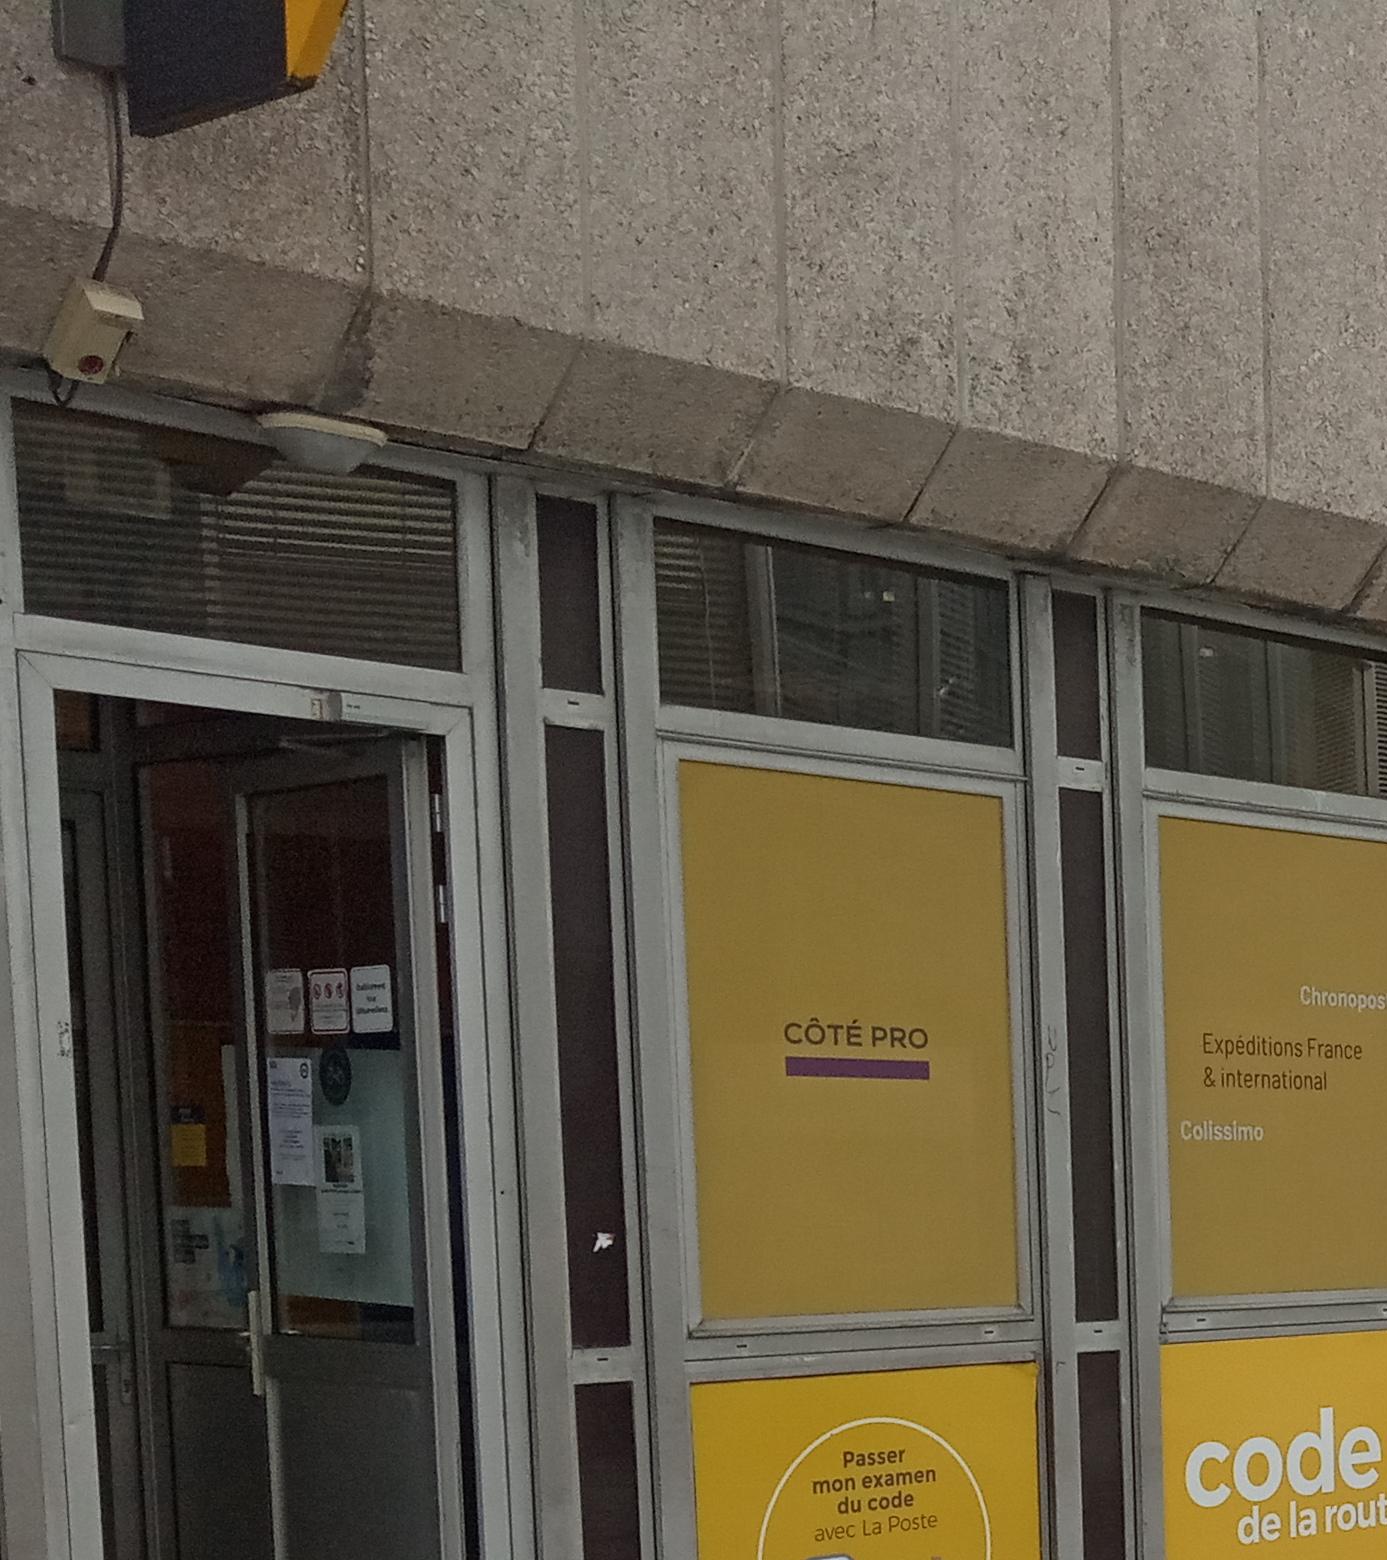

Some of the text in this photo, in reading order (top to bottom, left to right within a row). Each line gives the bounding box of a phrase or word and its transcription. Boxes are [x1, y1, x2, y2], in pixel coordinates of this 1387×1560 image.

[784, 1017, 929, 1049] CÔTÉ PRO
[1202, 1032, 1363, 1060] Expéditions France
[1203, 1066, 1327, 1090] & international
[1180, 1119, 1264, 1141] Colissimo
[842, 1449, 906, 1468] Passer
[1185, 1406, 1383, 1508] code
[812, 1469, 936, 1494] mon examen
[837, 1490, 914, 1514] du code
[814, 1513, 938, 1542] avec La Poste
[1237, 1505, 1282, 1545] de
[1289, 1500, 1318, 1538] la
